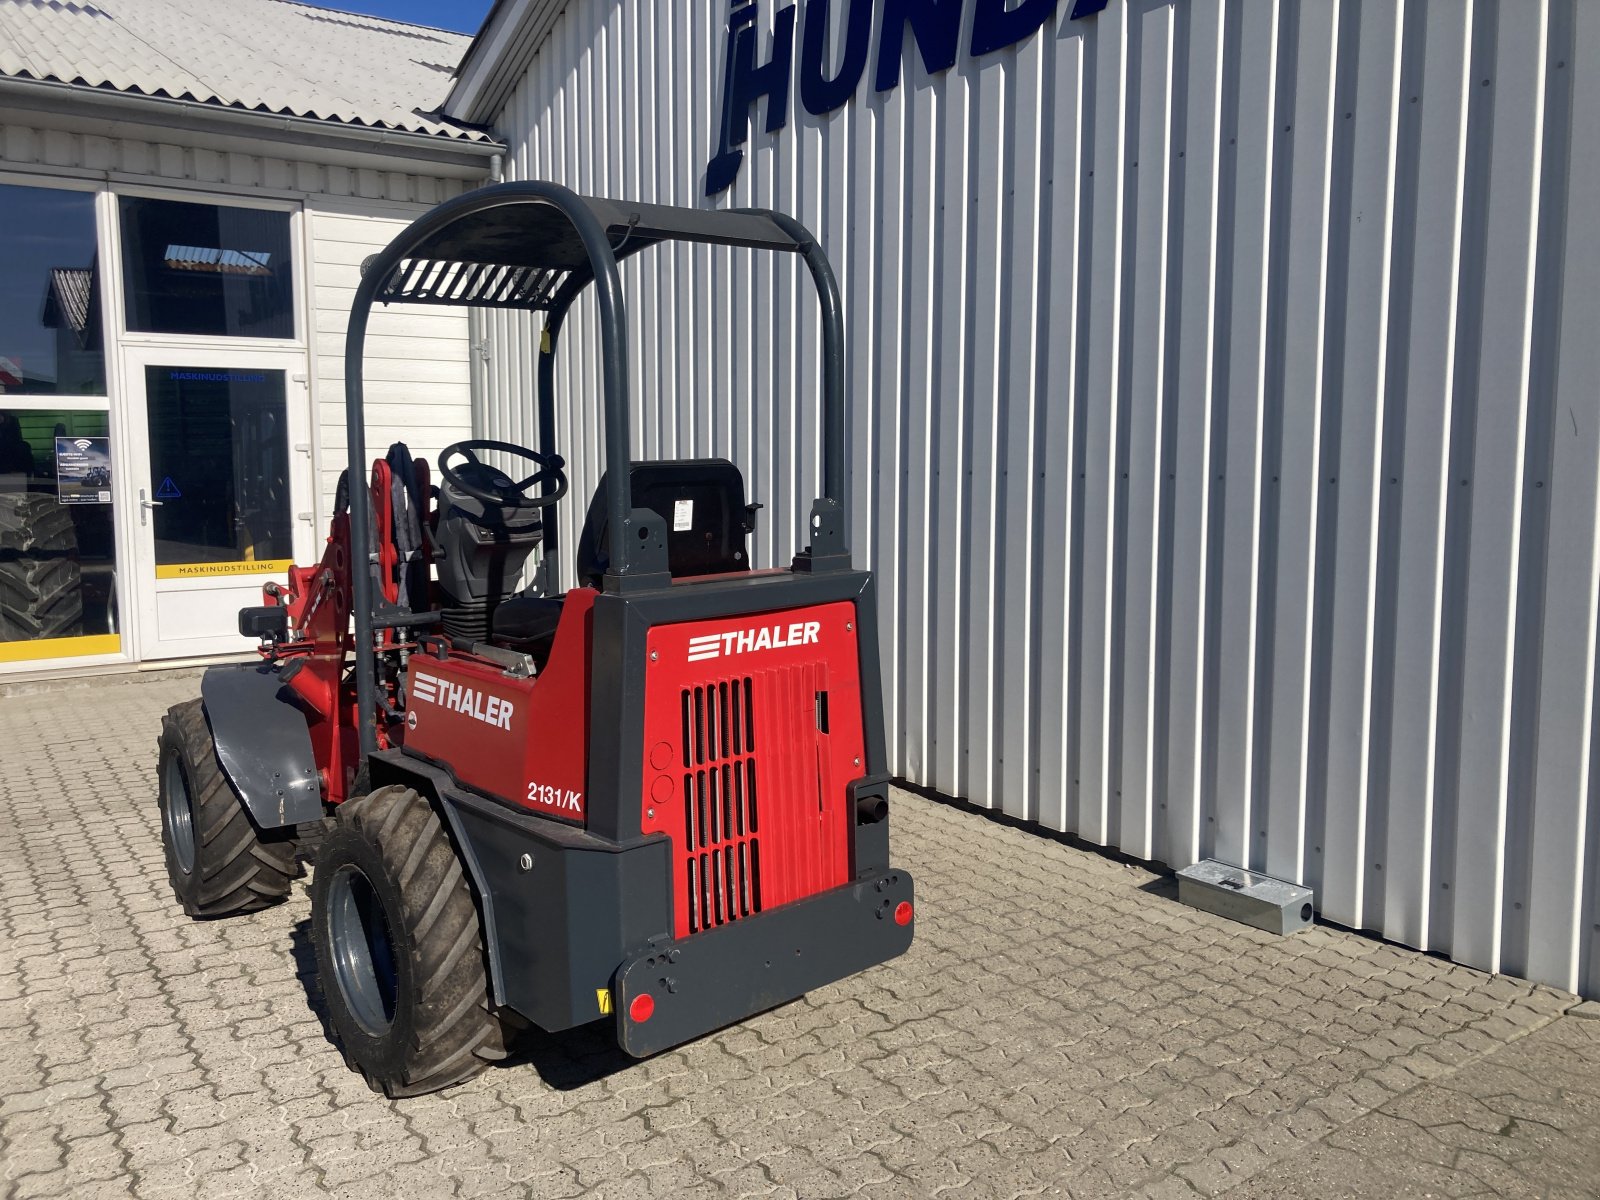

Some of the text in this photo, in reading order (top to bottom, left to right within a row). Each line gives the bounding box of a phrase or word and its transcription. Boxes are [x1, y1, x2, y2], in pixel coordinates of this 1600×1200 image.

[170, 371, 265, 383] MASKINUDSTILLING
[179, 563, 274, 574] MASKINUDSTILLING
[721, 621, 821, 656] THALER
[437, 678, 514, 731] THALER
[527, 781, 582, 812] 2131/K
